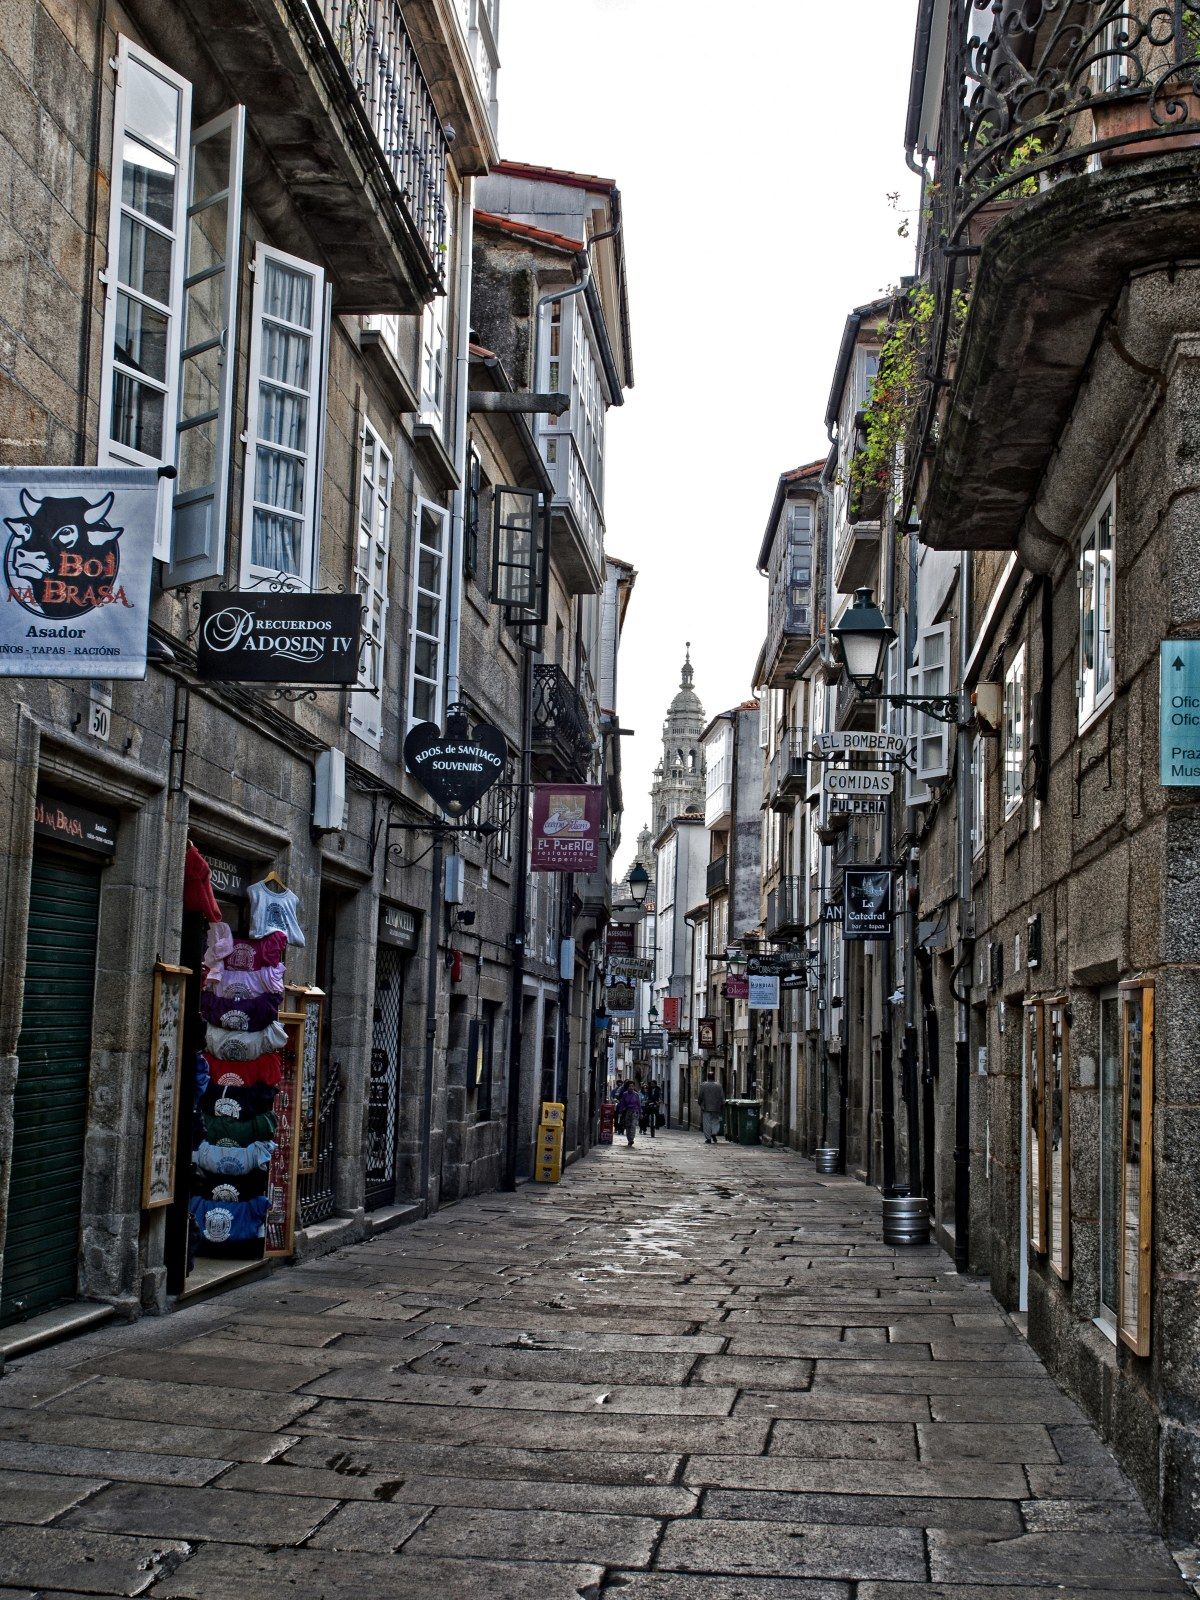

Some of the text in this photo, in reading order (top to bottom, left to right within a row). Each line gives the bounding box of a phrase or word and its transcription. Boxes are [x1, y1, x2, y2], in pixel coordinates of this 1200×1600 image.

[7, 577, 134, 608] NA BRASA
[255, 619, 332, 630] RECUERDOS
[25, 625, 86, 638] Asador
[31, 646, 66, 655] TAPAS
[73, 645, 121, 656] RACIÓNS
[331, 637, 353, 652] IV
[1171, 696, 1200, 708] Ofic
[93, 708, 107, 737] 50
[1171, 713, 1200, 726] Ofic
[821, 734, 903, 751] EL BOMBERO
[414, 744, 502, 767] RDOS. de SANTIAGO
[432, 760, 483, 772] SOUVENIRS
[829, 775, 890, 790] COMIDAS
[831, 800, 885, 812] PULPERIA
[56, 808, 84, 839] BRASA
[538, 839, 549, 850] EL
[862, 899, 875, 908] La
[848, 911, 886, 920] Catedral
